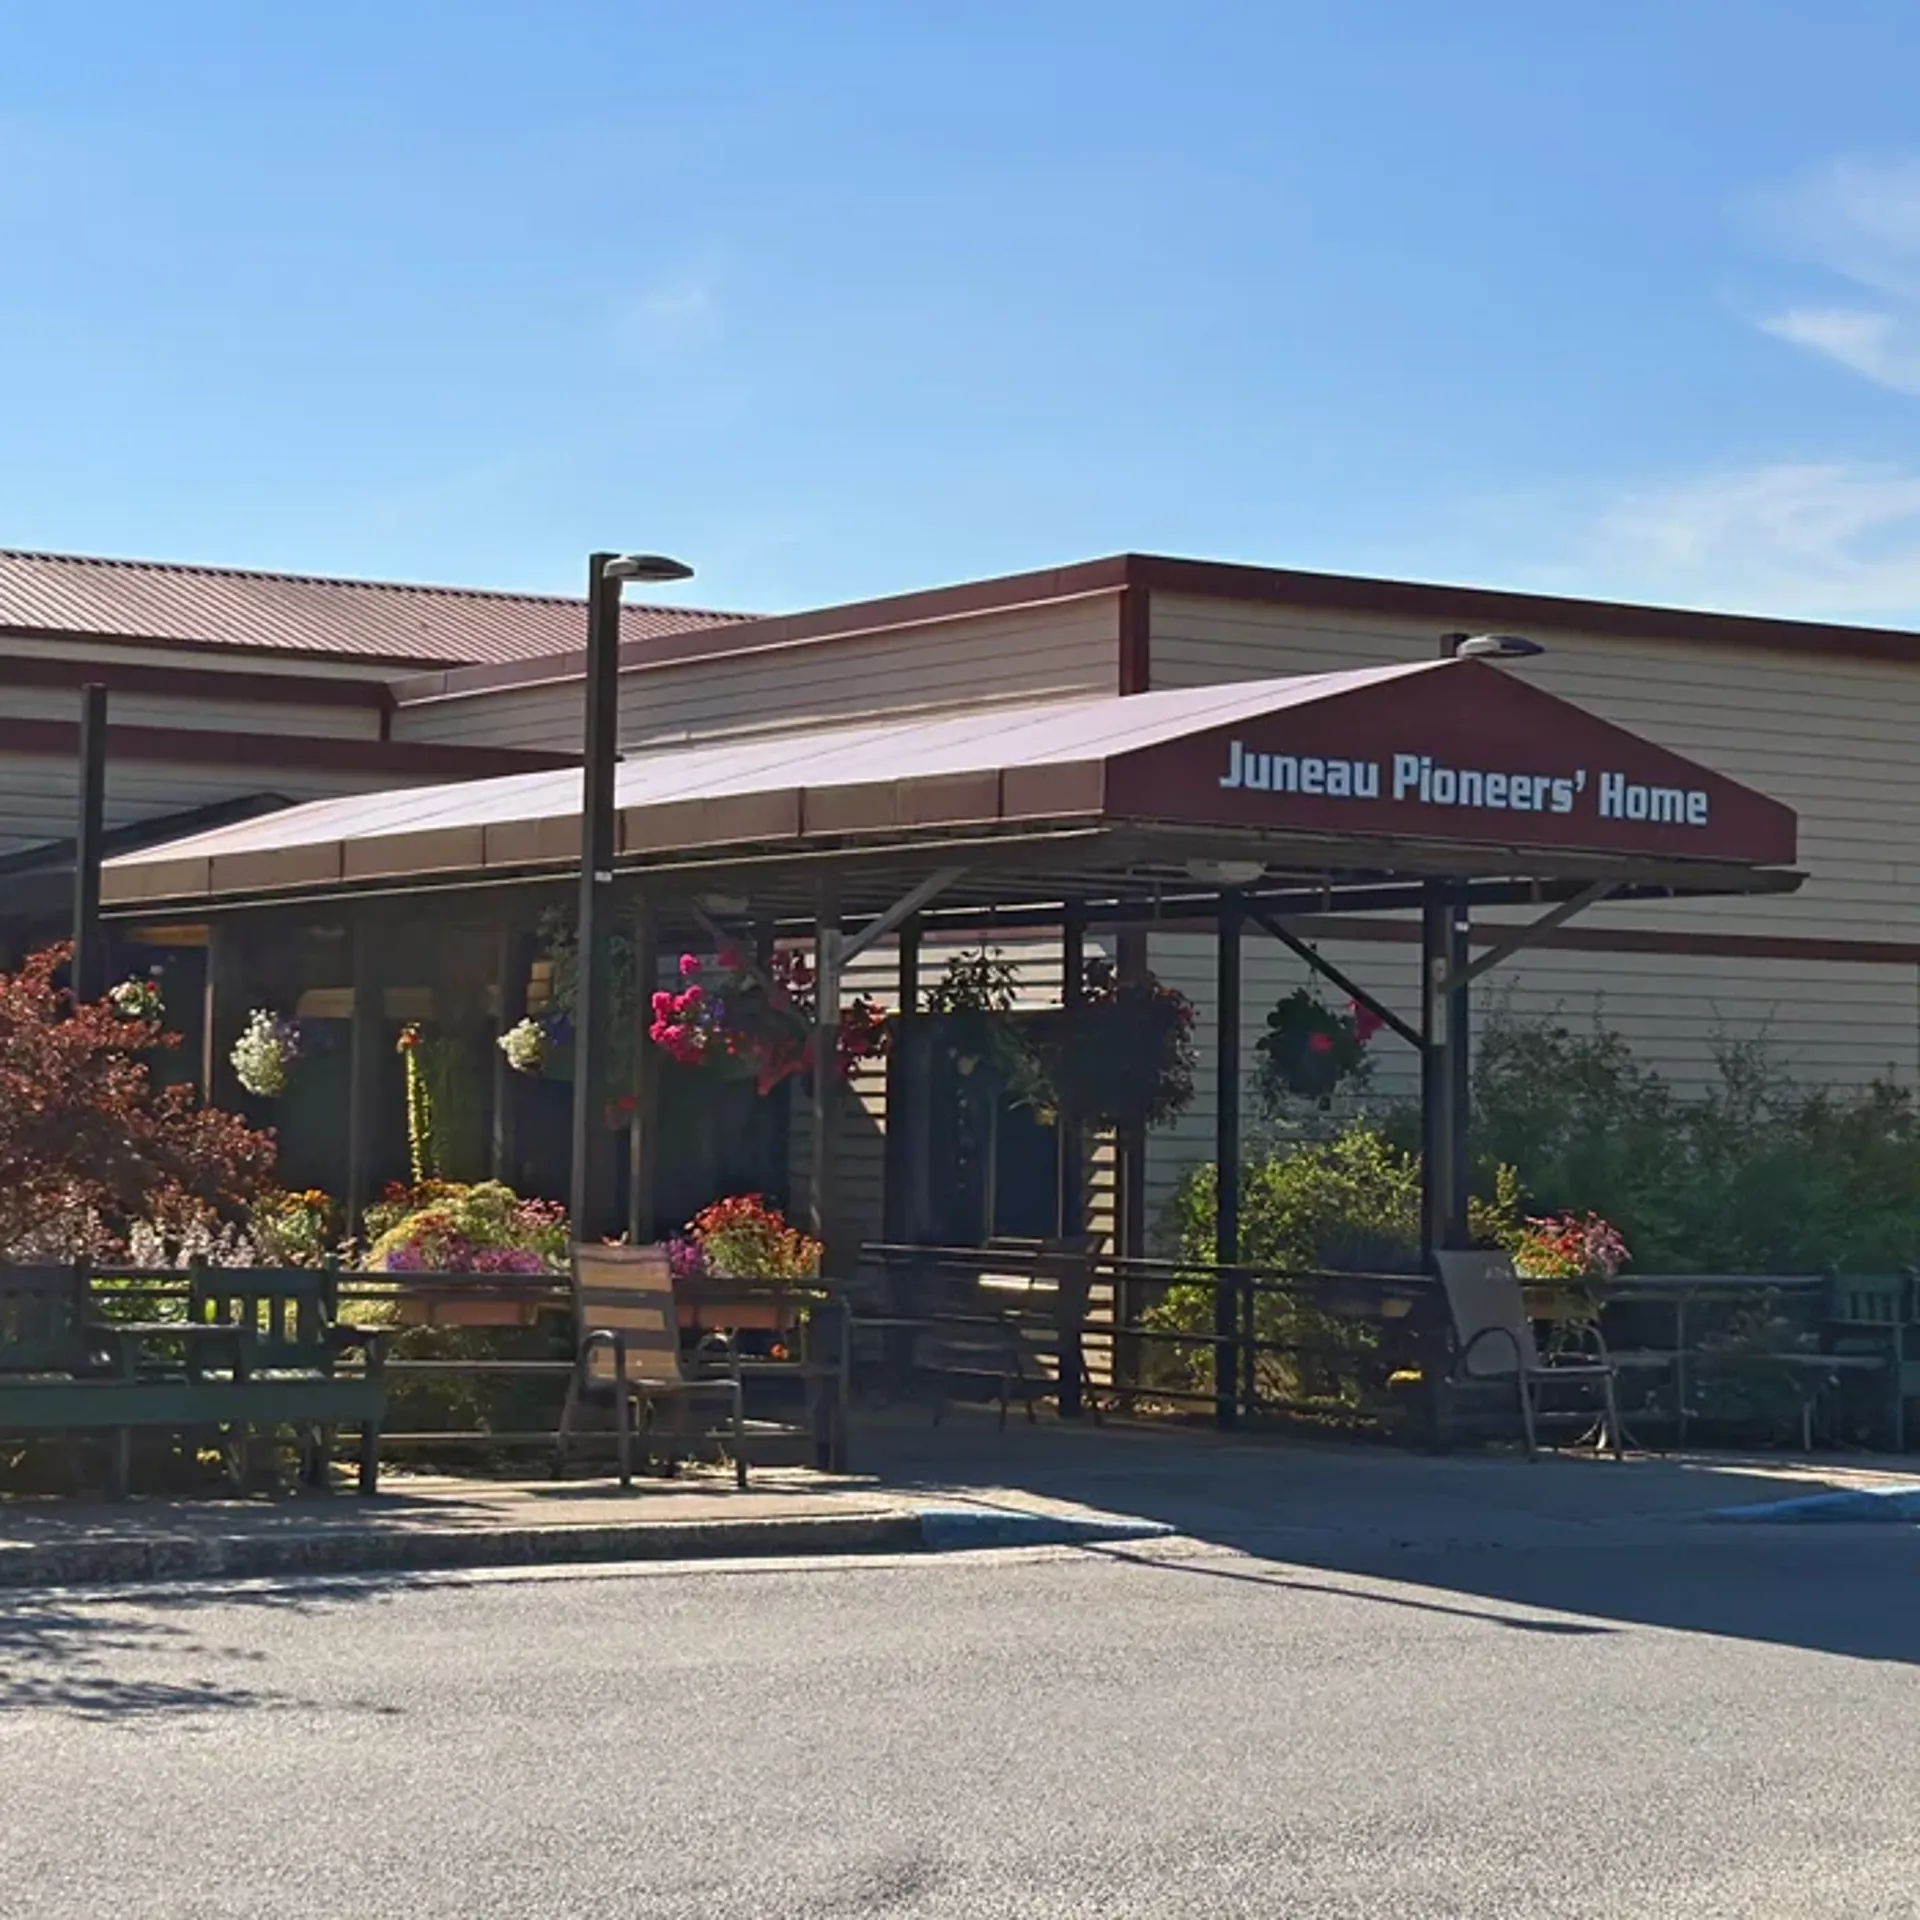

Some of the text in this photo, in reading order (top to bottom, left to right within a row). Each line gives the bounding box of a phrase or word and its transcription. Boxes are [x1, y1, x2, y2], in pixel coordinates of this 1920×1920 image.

[1219, 740, 1708, 824] Juneau Pioneers’ Home
